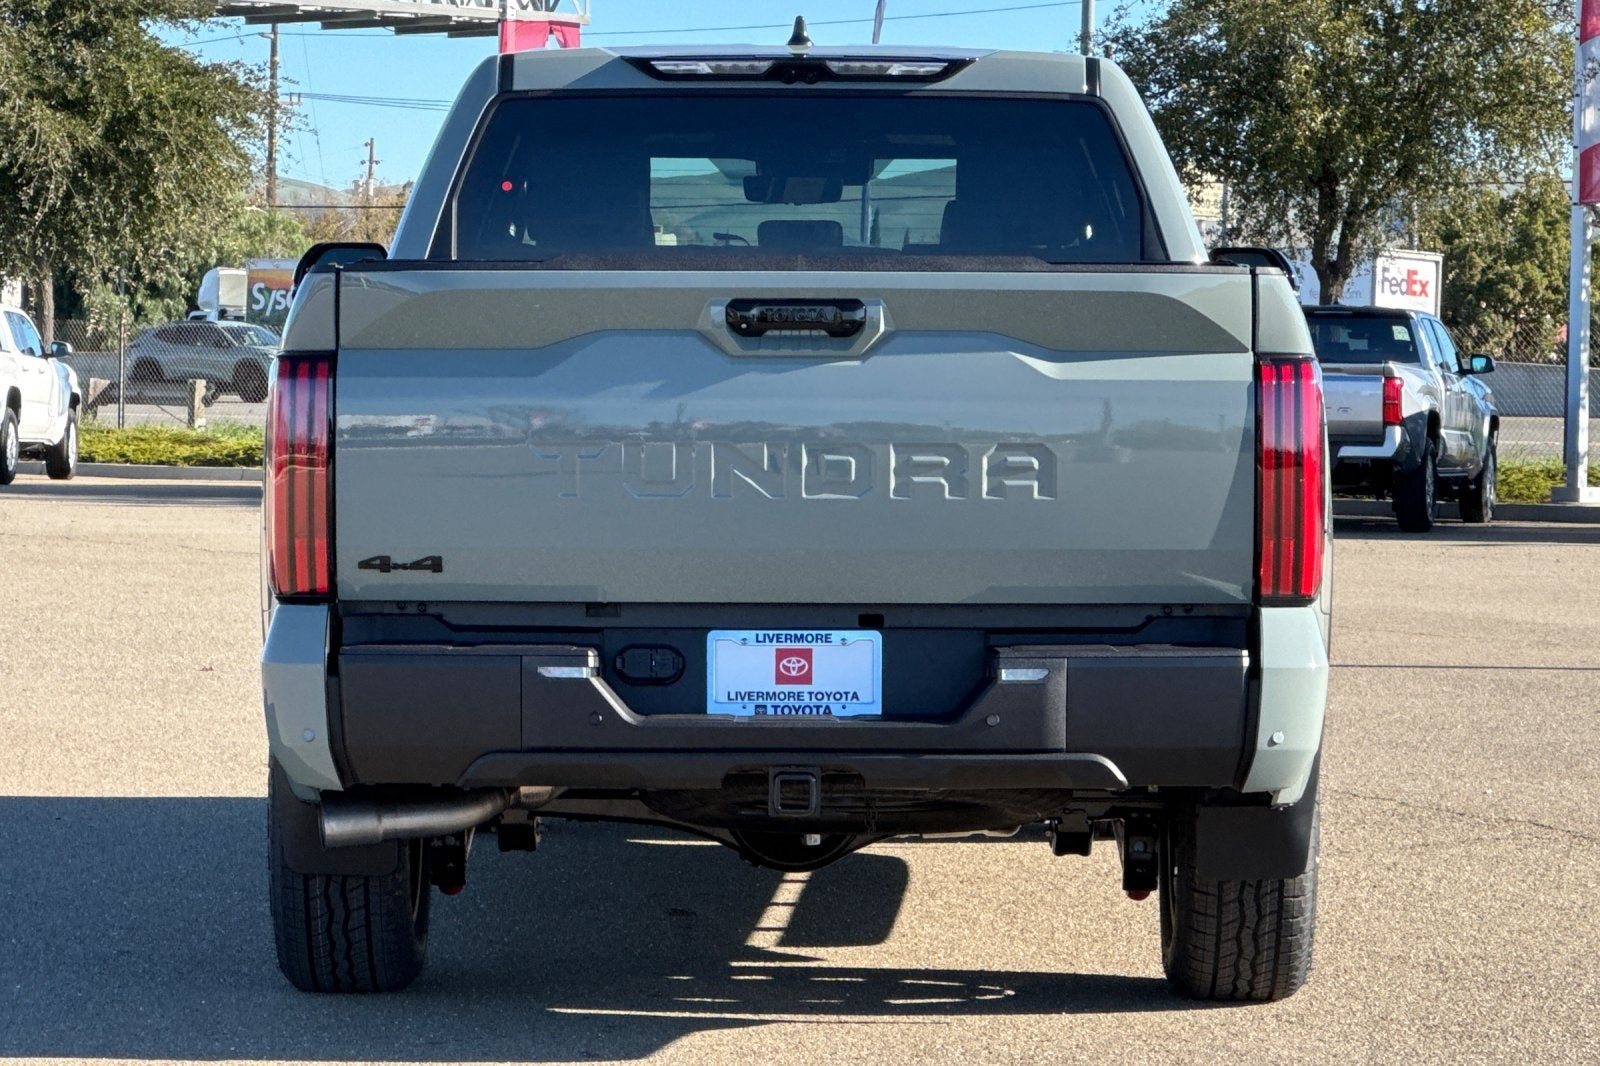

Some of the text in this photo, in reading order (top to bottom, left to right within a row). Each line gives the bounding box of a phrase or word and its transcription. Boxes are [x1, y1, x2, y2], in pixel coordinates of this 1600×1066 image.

[1381, 266, 1430, 298] FedEx
[528, 442, 1058, 500] TUNDRA
[755, 633, 833, 643] LIVERMORE
[727, 691, 860, 702] LIVERMORE TOYOTA
[771, 705, 832, 715] TOYOTA
